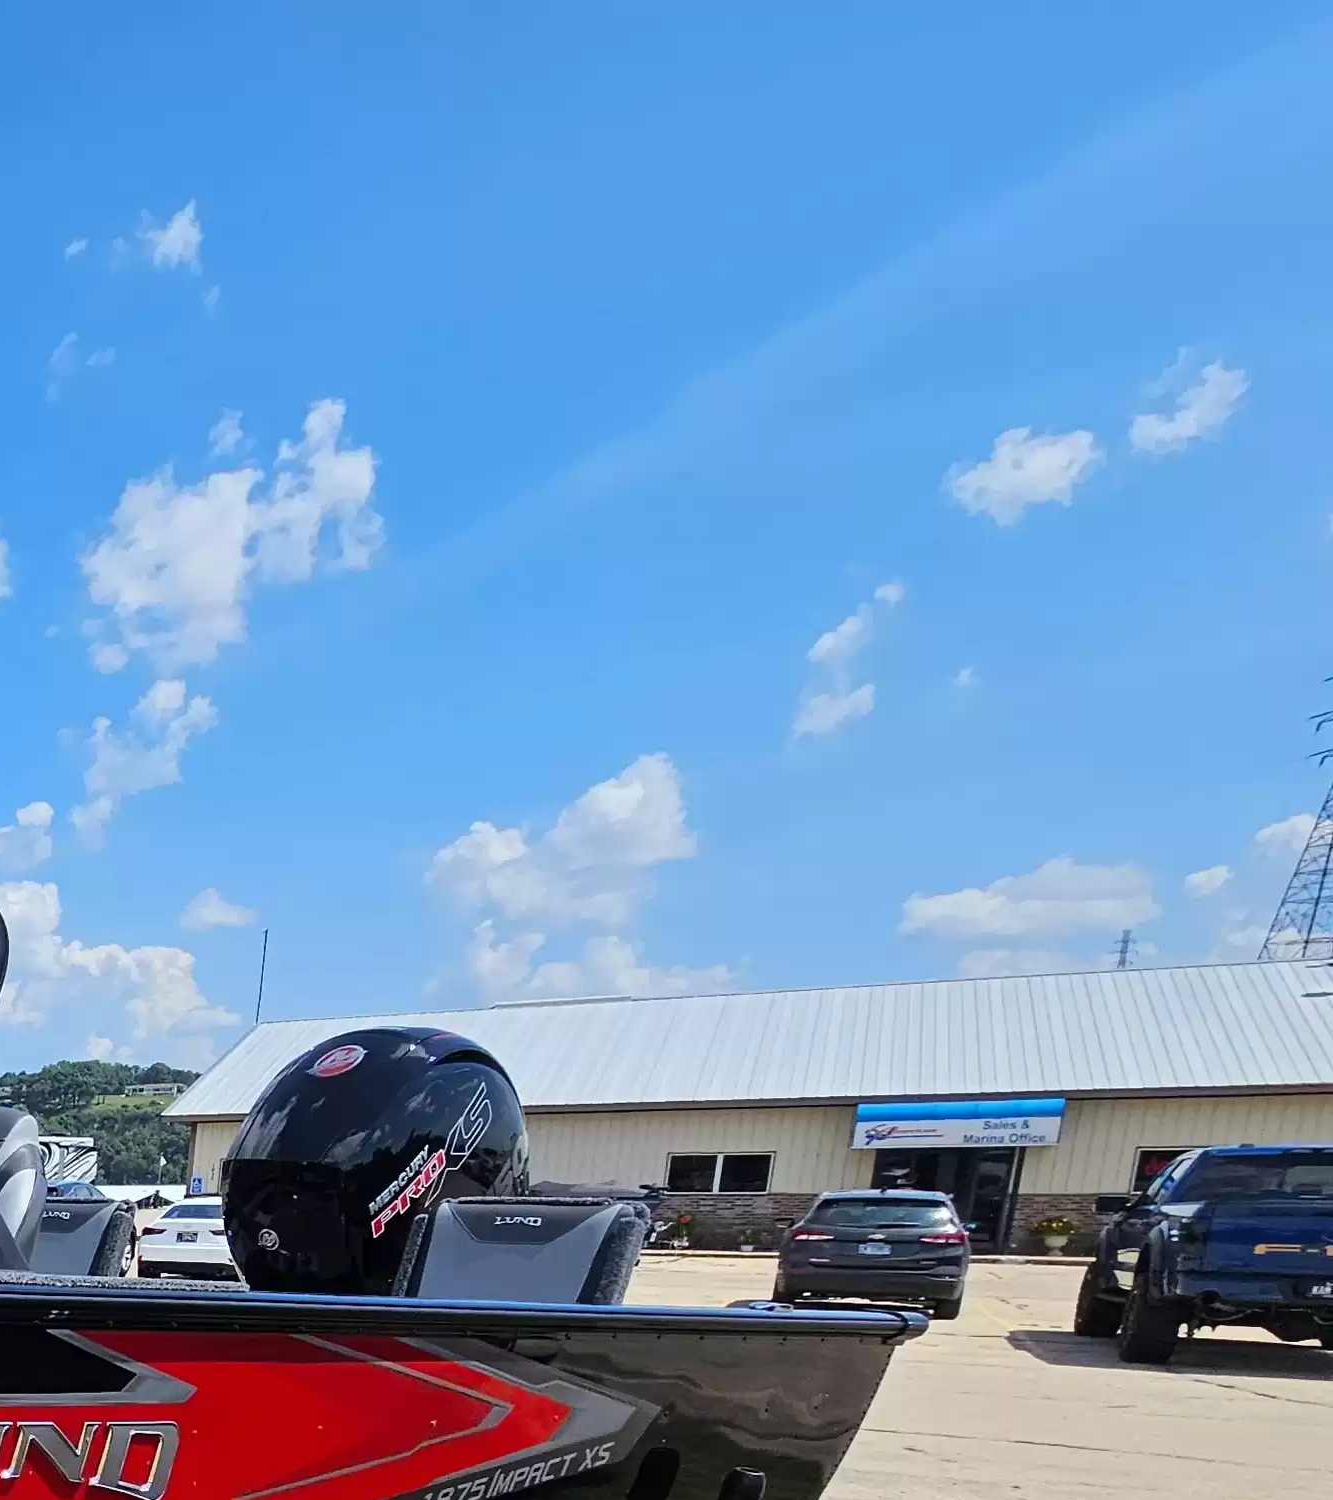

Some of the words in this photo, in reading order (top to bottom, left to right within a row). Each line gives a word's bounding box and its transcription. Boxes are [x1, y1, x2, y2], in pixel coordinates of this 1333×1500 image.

[983, 1120, 1016, 1130] Sales
[1021, 1119, 1030, 1130] &
[963, 1134, 1004, 1144] Marina
[1009, 1133, 1046, 1143] Office
[368, 1144, 429, 1215] MERCURY
[371, 1149, 446, 1238] PRO
[494, 1216, 542, 1226] LUND
[578, 1442, 616, 1472] XS
